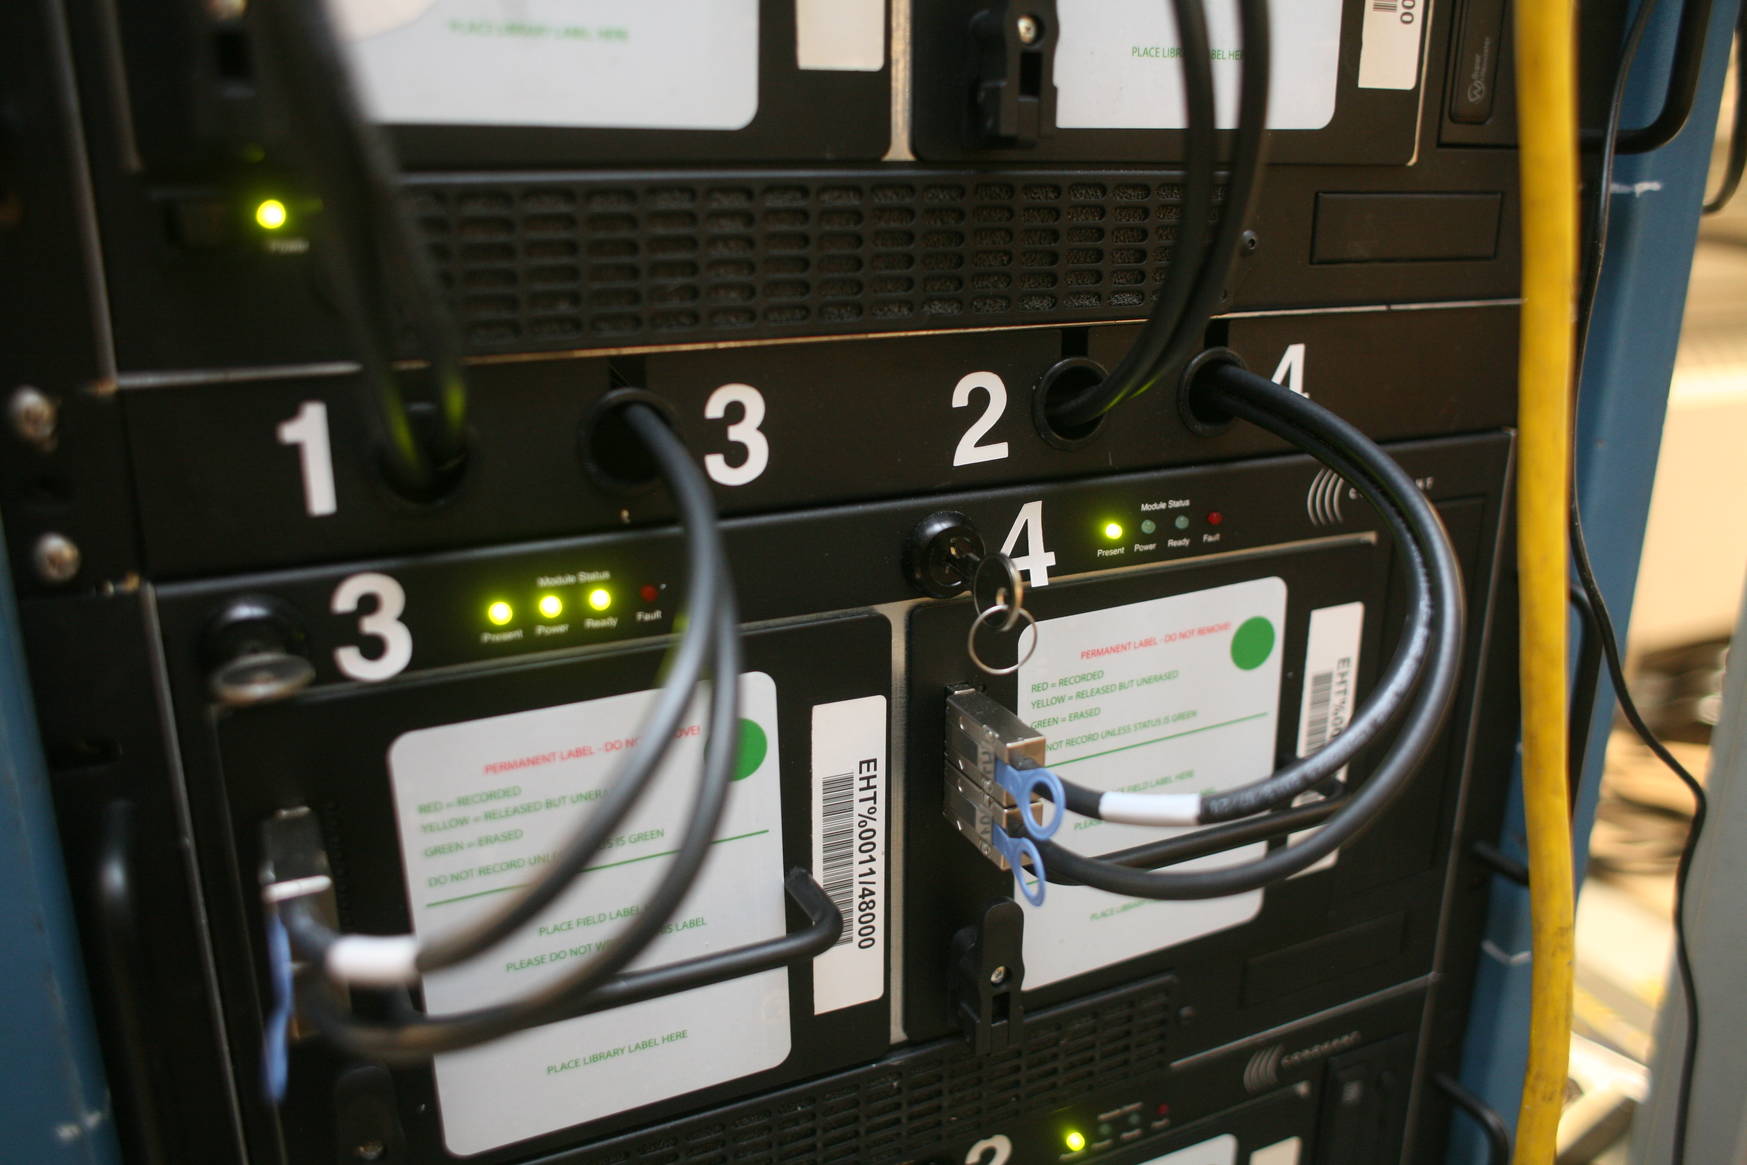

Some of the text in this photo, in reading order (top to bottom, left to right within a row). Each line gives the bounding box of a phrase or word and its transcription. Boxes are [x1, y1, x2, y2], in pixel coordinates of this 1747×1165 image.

[1131, 45, 1161, 58] PLACE
[951, 371, 1009, 467] 2
[703, 383, 770, 487] 3
[276, 399, 338, 517] 1
[1140, 499, 1191, 512] Module Status
[999, 500, 1056, 588] 4
[1096, 547, 1125, 558] Present
[1134, 542, 1157, 552] Power
[1167, 538, 1191, 547] Ready
[1203, 533, 1221, 543] Fault
[330, 572, 413, 683] 3
[1080, 640, 1132, 660] PERMANENT
[1133, 636, 1158, 649] LABEL
[1164, 632, 1178, 644] DO
[1179, 628, 1196, 640] NOT
[1030, 694, 1067, 710] YELLOW
[1075, 683, 1117, 700] RELEASED
[1118, 679, 1135, 692] BUT
[1136, 670, 1180, 687] UNERASED
[1031, 681, 1049, 694] RED
[1058, 670, 1105, 688] RECORDED
[1030, 716, 1059, 730] GREEN
[1068, 706, 1102, 723] ERASED
[1065, 732, 1099, 747] RECORD
[1100, 723, 1133, 739] UNLESS
[483, 751, 557, 776] PERMANENT
[559, 745, 595, 761] LABEL
[604, 738, 623, 754] DO
[417, 800, 444, 815] RED
[456, 785, 523, 807] RECORDED
[421, 815, 470, 833] YELLOW
[483, 800, 543, 821] RELEASED
[545, 796, 567, 811] BUT
[424, 840, 465, 858] GREEN
[477, 828, 524, 847] ERASED
[627, 827, 665, 844] GREEN
[857, 757, 878, 950] EHT%0011/48000
[427, 873, 449, 888] DO
[450, 867, 478, 883] NOT
[477, 857, 525, 877] RECORD
[538, 905, 641, 937] PLACE FIELD LABEL
[674, 916, 707, 932] LABEL
[506, 953, 547, 973] PLEASE
[549, 949, 568, 963] DO
[569, 942, 594, 957] NOT
[546, 1029, 689, 1075] PLACE LIBRARY LABEL HERE
